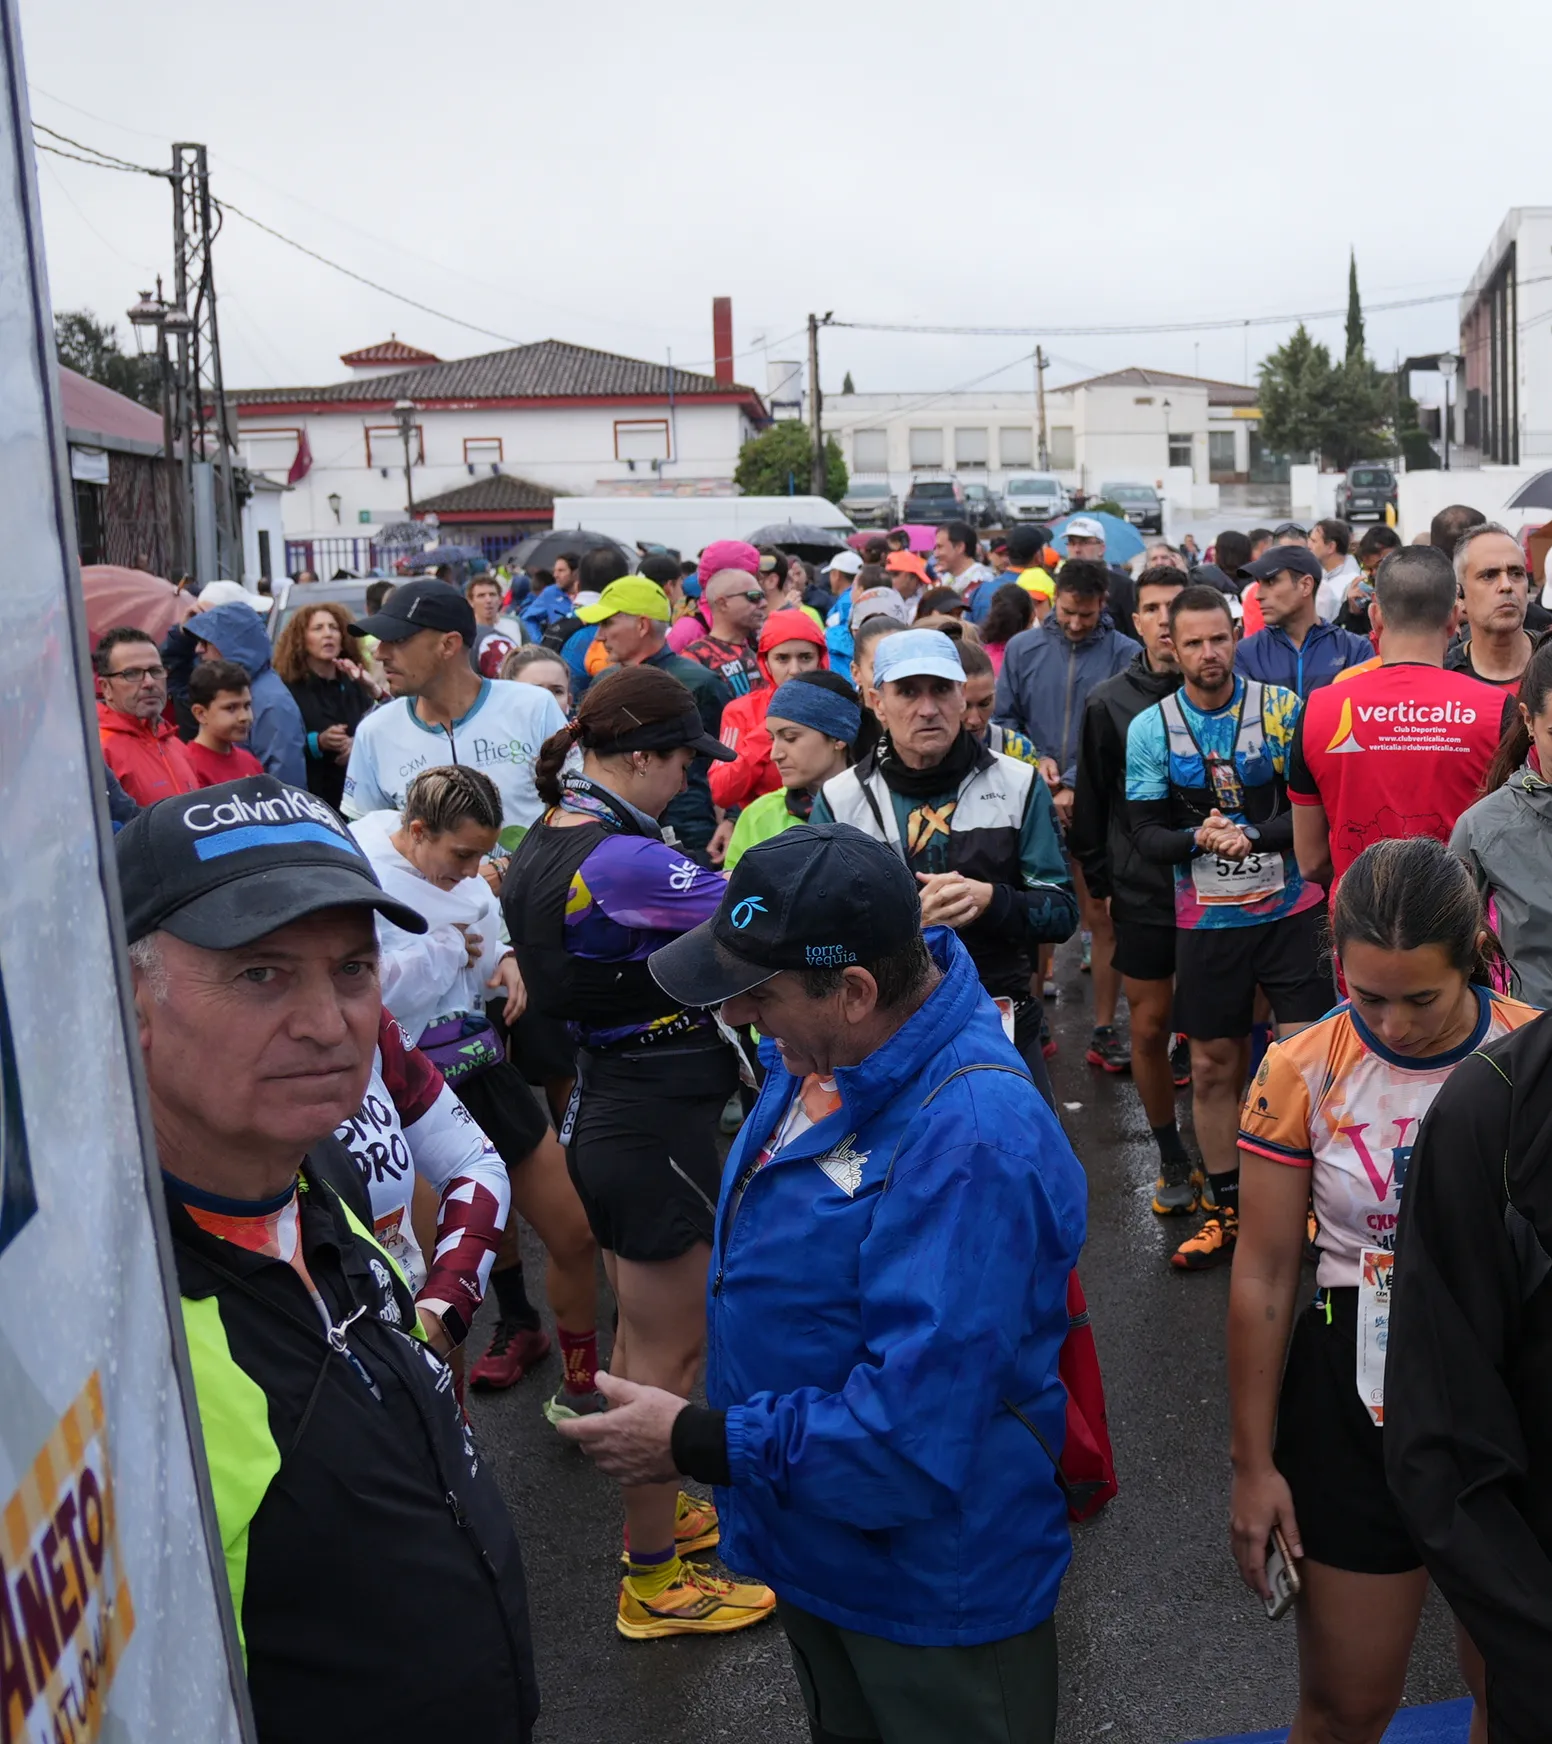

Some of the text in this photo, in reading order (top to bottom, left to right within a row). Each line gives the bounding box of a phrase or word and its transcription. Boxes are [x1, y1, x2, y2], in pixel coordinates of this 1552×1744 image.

[1357, 700, 1477, 724] verticalia
[1411, 726, 1447, 734] Deportivo
[1378, 735, 1461, 743] www.clubverticalia.com
[473, 738, 533, 764] Priego
[1369, 744, 1471, 753] verticalia@clubverticalia.com
[1216, 854, 1262, 877] 523
[805, 944, 844, 957] torre
[805, 950, 857, 968] vequia
